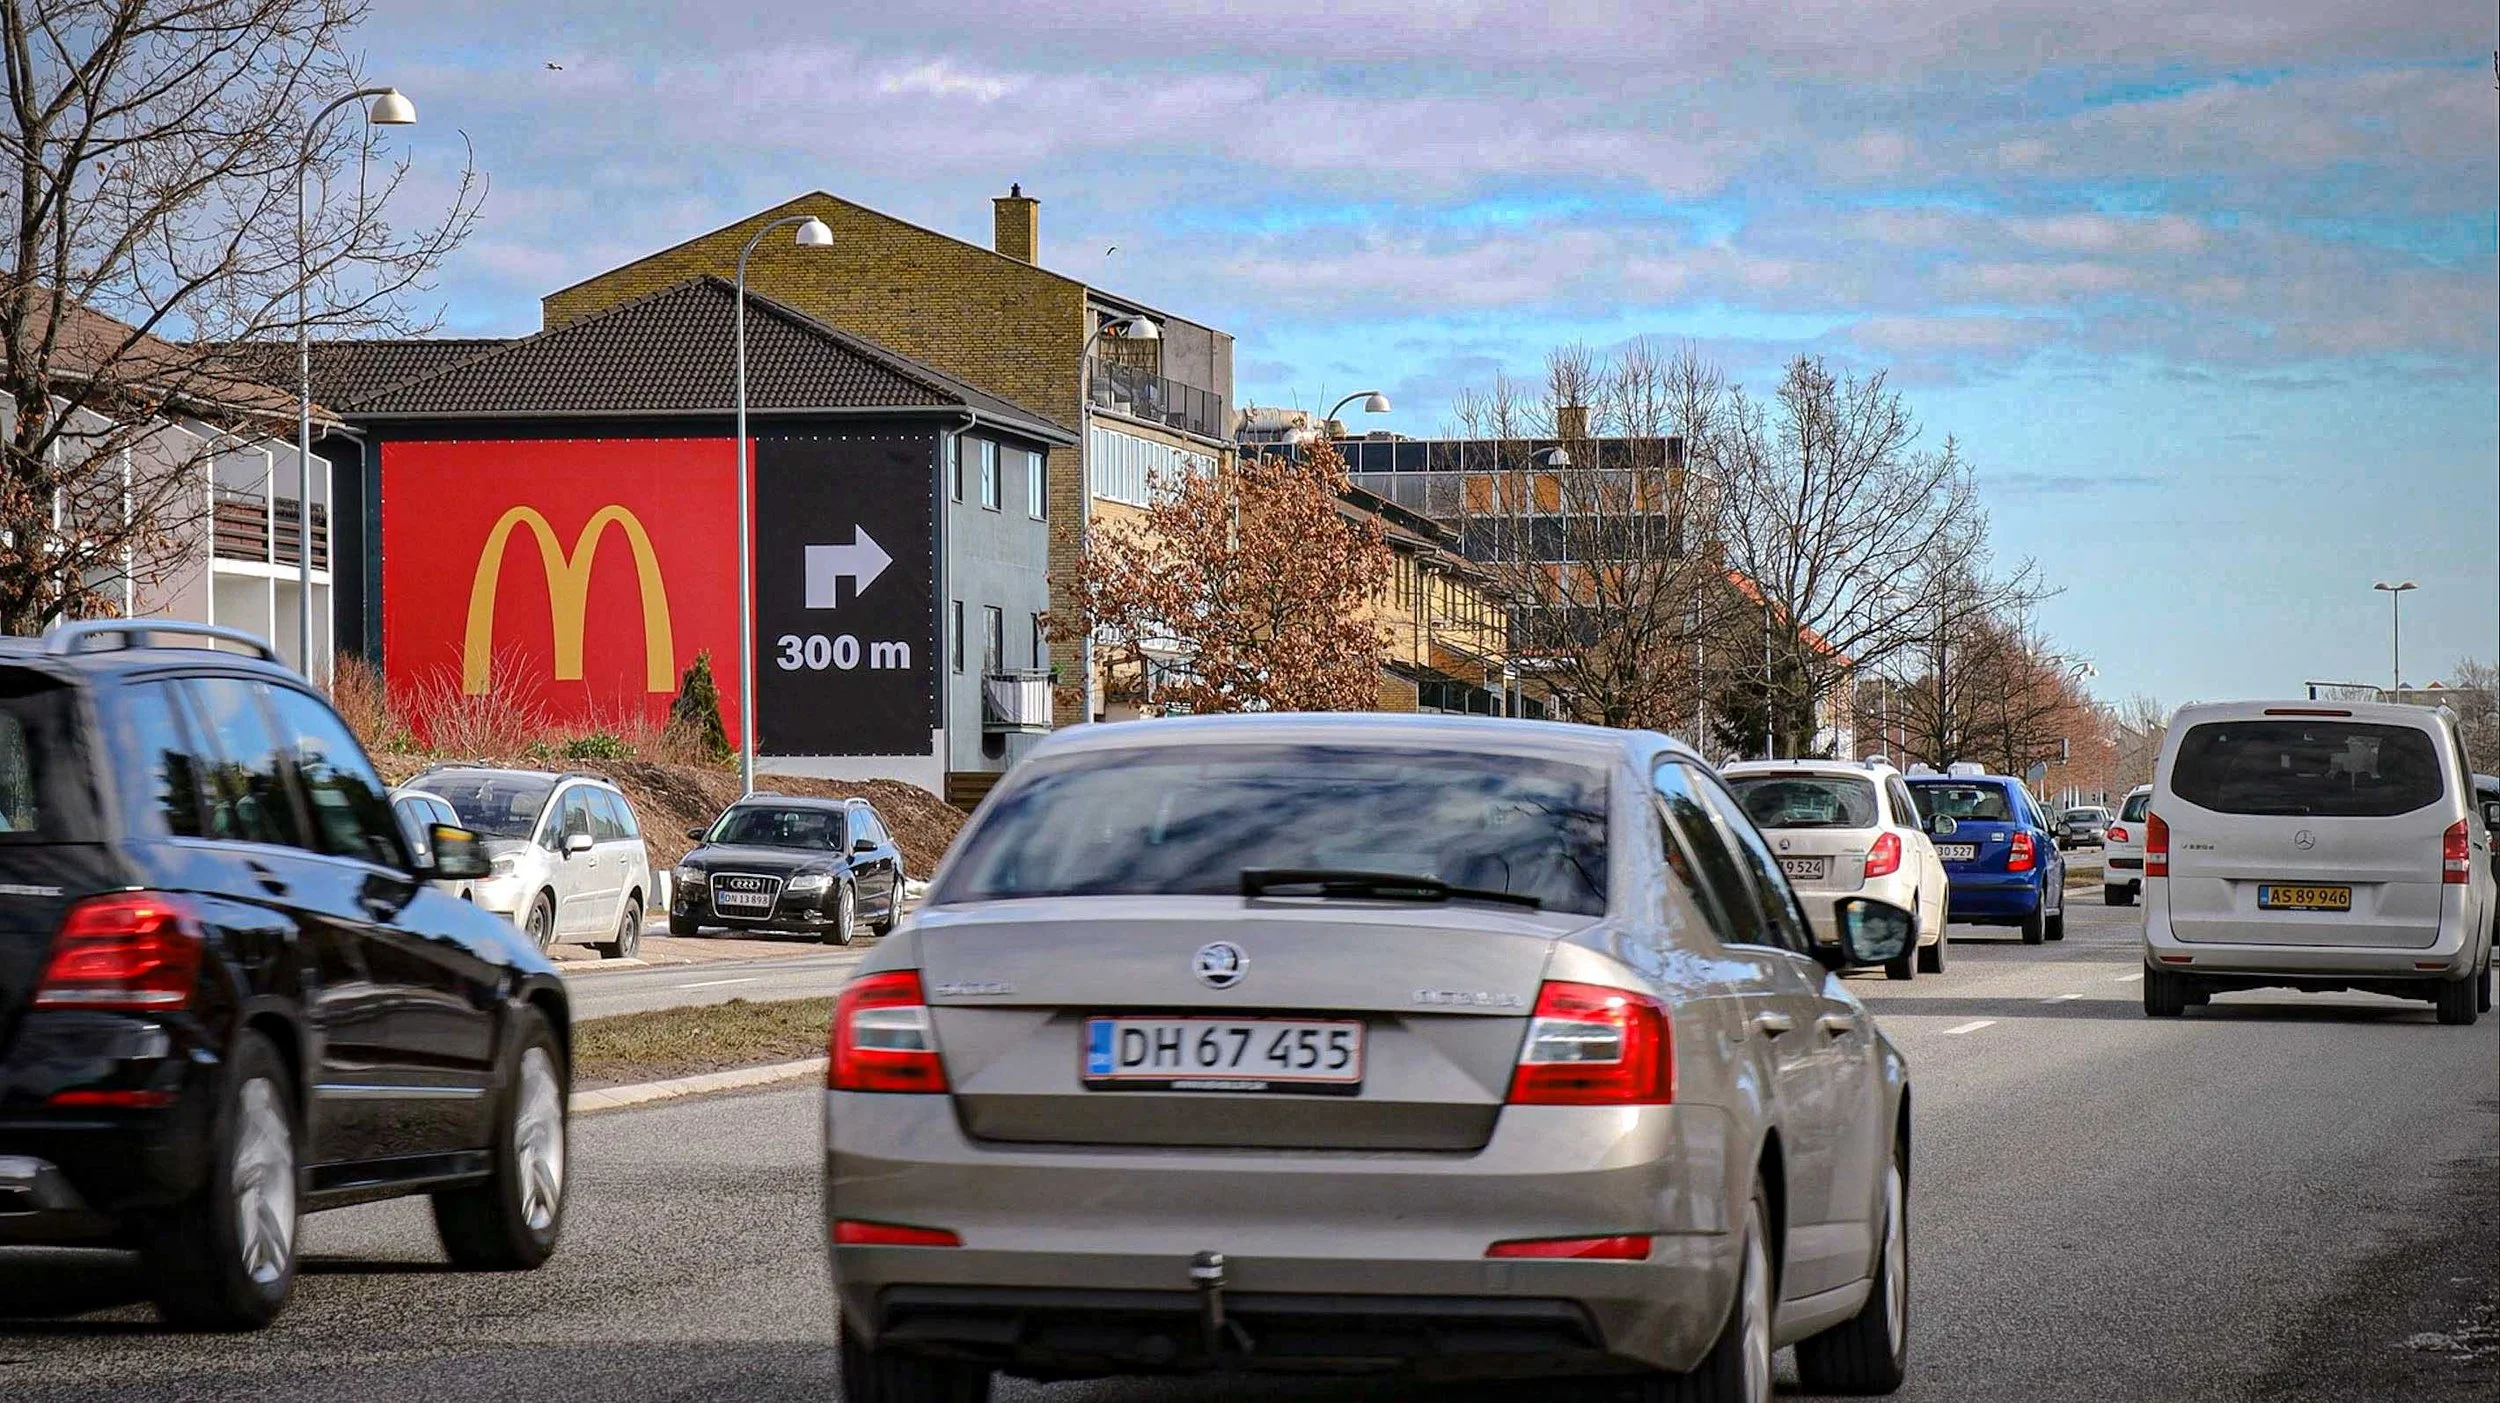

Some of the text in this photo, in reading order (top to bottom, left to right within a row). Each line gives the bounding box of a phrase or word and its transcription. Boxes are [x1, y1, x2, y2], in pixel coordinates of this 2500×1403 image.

[776, 634, 911, 671] 300 m
[1953, 846, 1972, 856] 527
[1797, 861, 1821, 873] 524
[740, 894, 749, 904] 13
[2270, 889, 2347, 905] AS 89 946
[1119, 1026, 1353, 1070] DH 67 455
